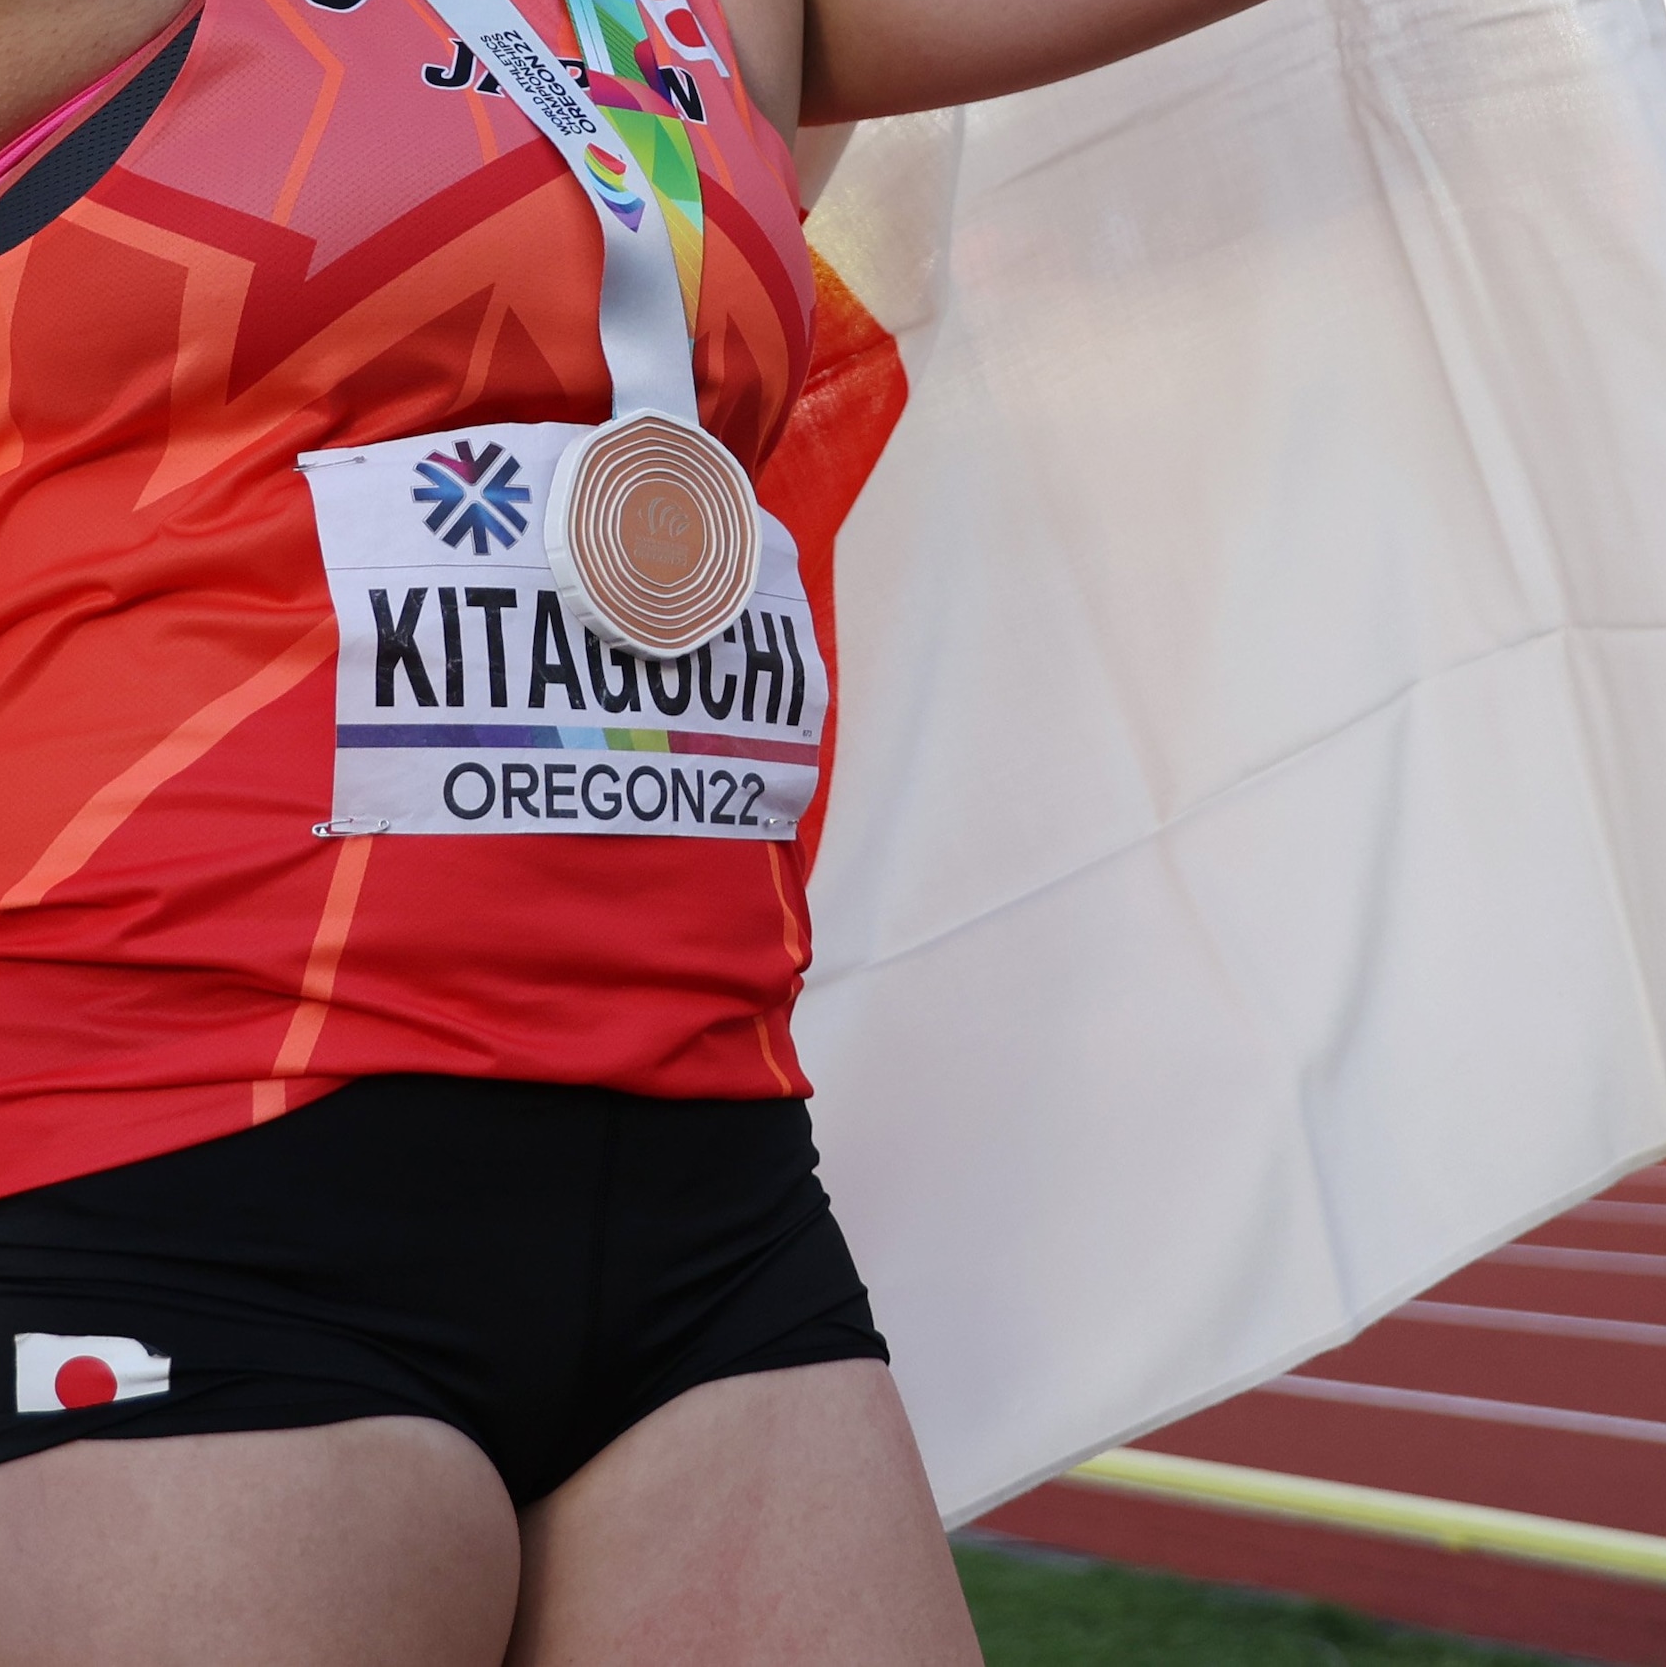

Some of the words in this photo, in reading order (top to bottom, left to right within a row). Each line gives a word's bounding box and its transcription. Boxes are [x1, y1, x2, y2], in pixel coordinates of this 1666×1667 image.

[480, 35, 536, 94] ATHLETICS
[491, 33, 583, 135] CHAMPIONSHIPS
[533, 96, 572, 136] WORLD
[443, 761, 765, 826] OREGON22
